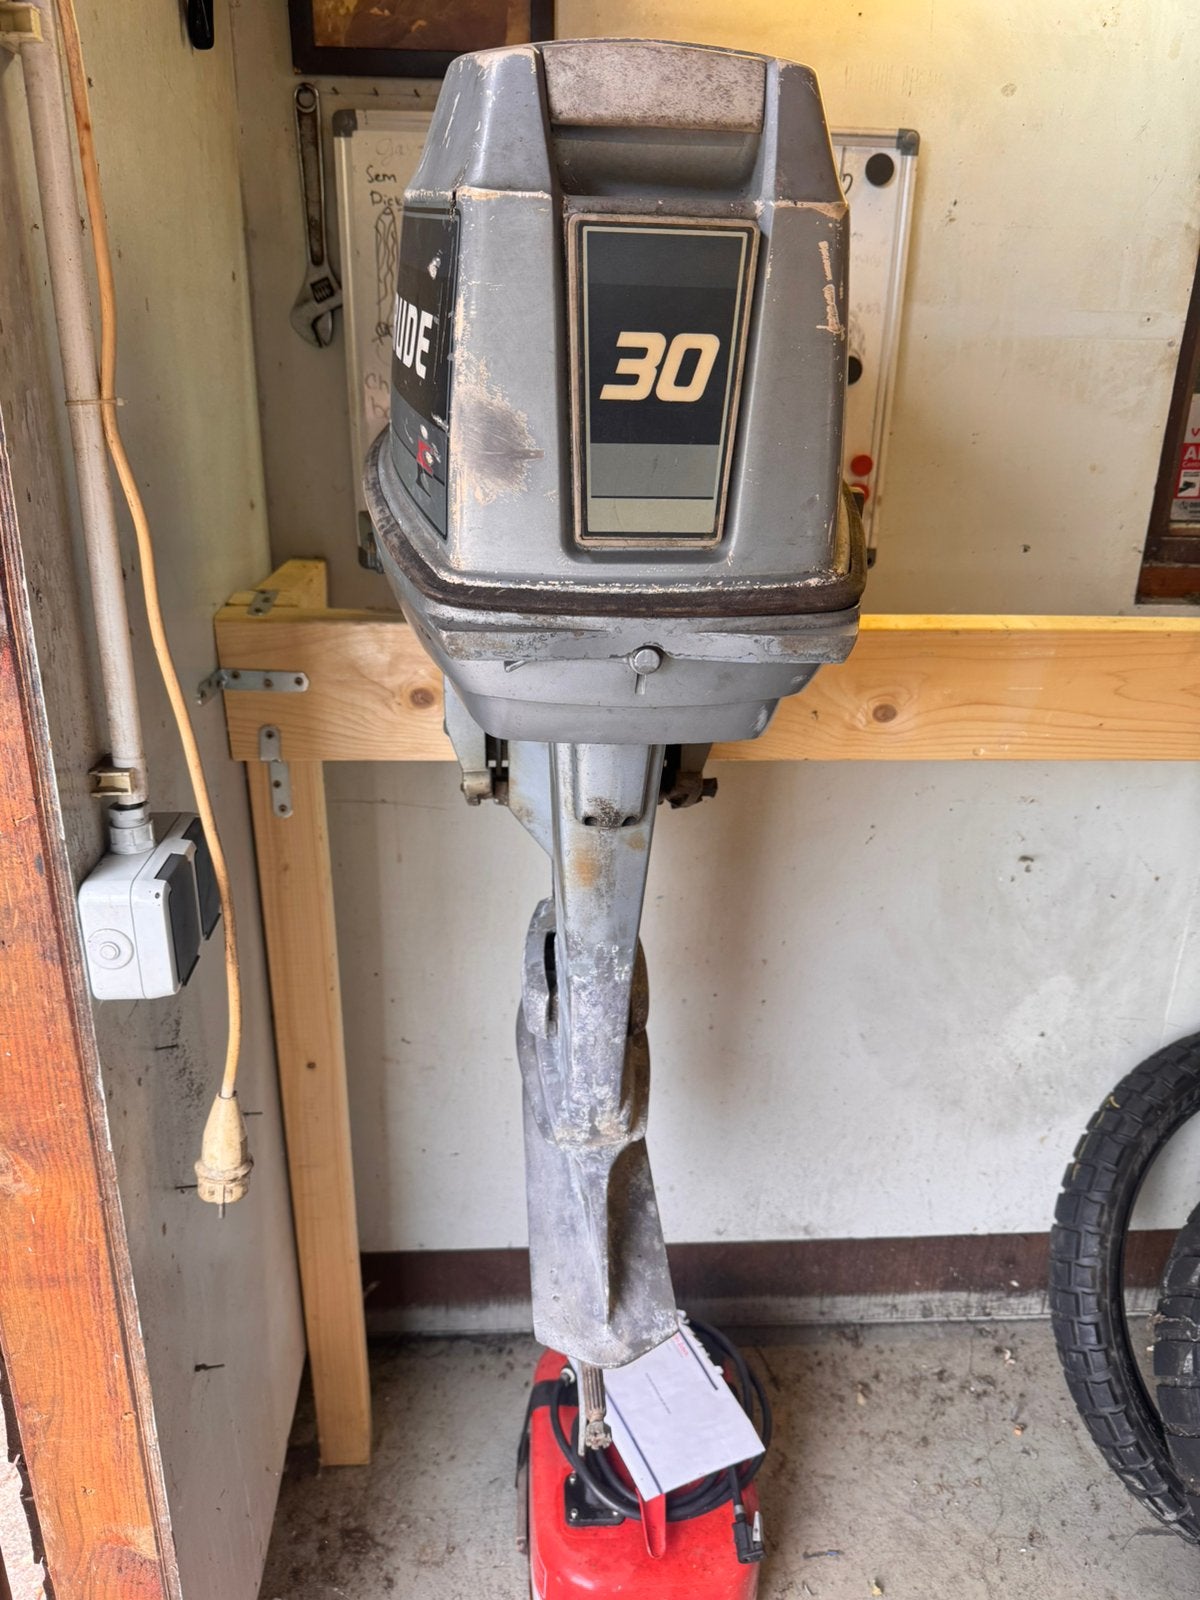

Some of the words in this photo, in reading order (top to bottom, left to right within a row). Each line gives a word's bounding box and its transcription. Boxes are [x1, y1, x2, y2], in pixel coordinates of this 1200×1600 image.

[365, 165, 397, 184] Sem
[600, 331, 720, 402] 30
[1184, 446, 1200, 460] A
